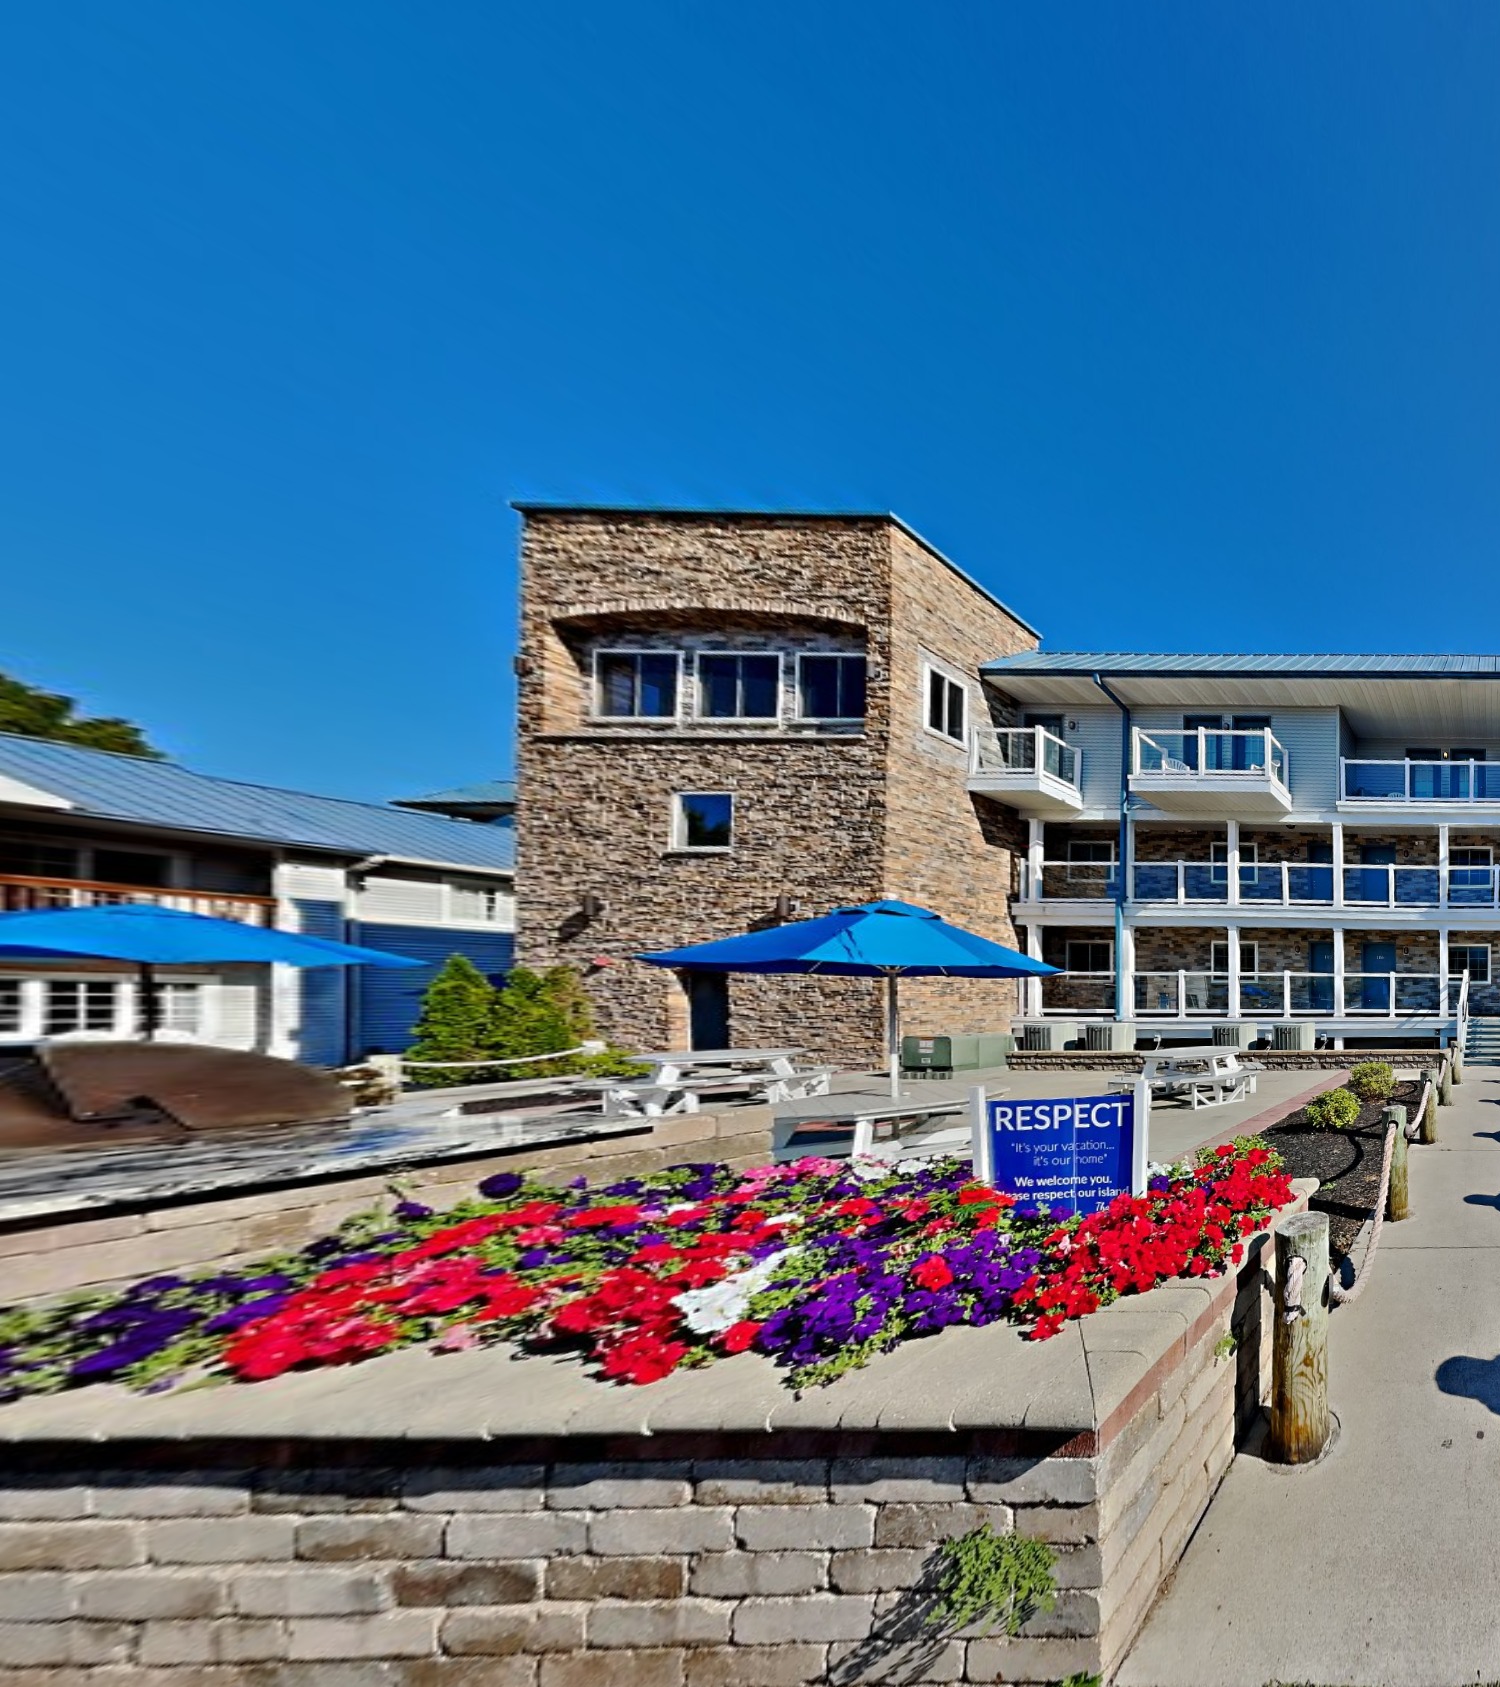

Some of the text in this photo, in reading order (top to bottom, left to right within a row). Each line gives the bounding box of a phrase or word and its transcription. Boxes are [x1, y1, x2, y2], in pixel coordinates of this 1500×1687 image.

[995, 1102, 1130, 1131] RESPECT
[1033, 1143, 1058, 1154] your
[1033, 1156, 1049, 1166] it's
[1051, 1156, 1070, 1165] our
[1014, 1174, 1112, 1187] We welcome you.
[1032, 1189, 1075, 1201] respect
[1078, 1189, 1096, 1198] our
